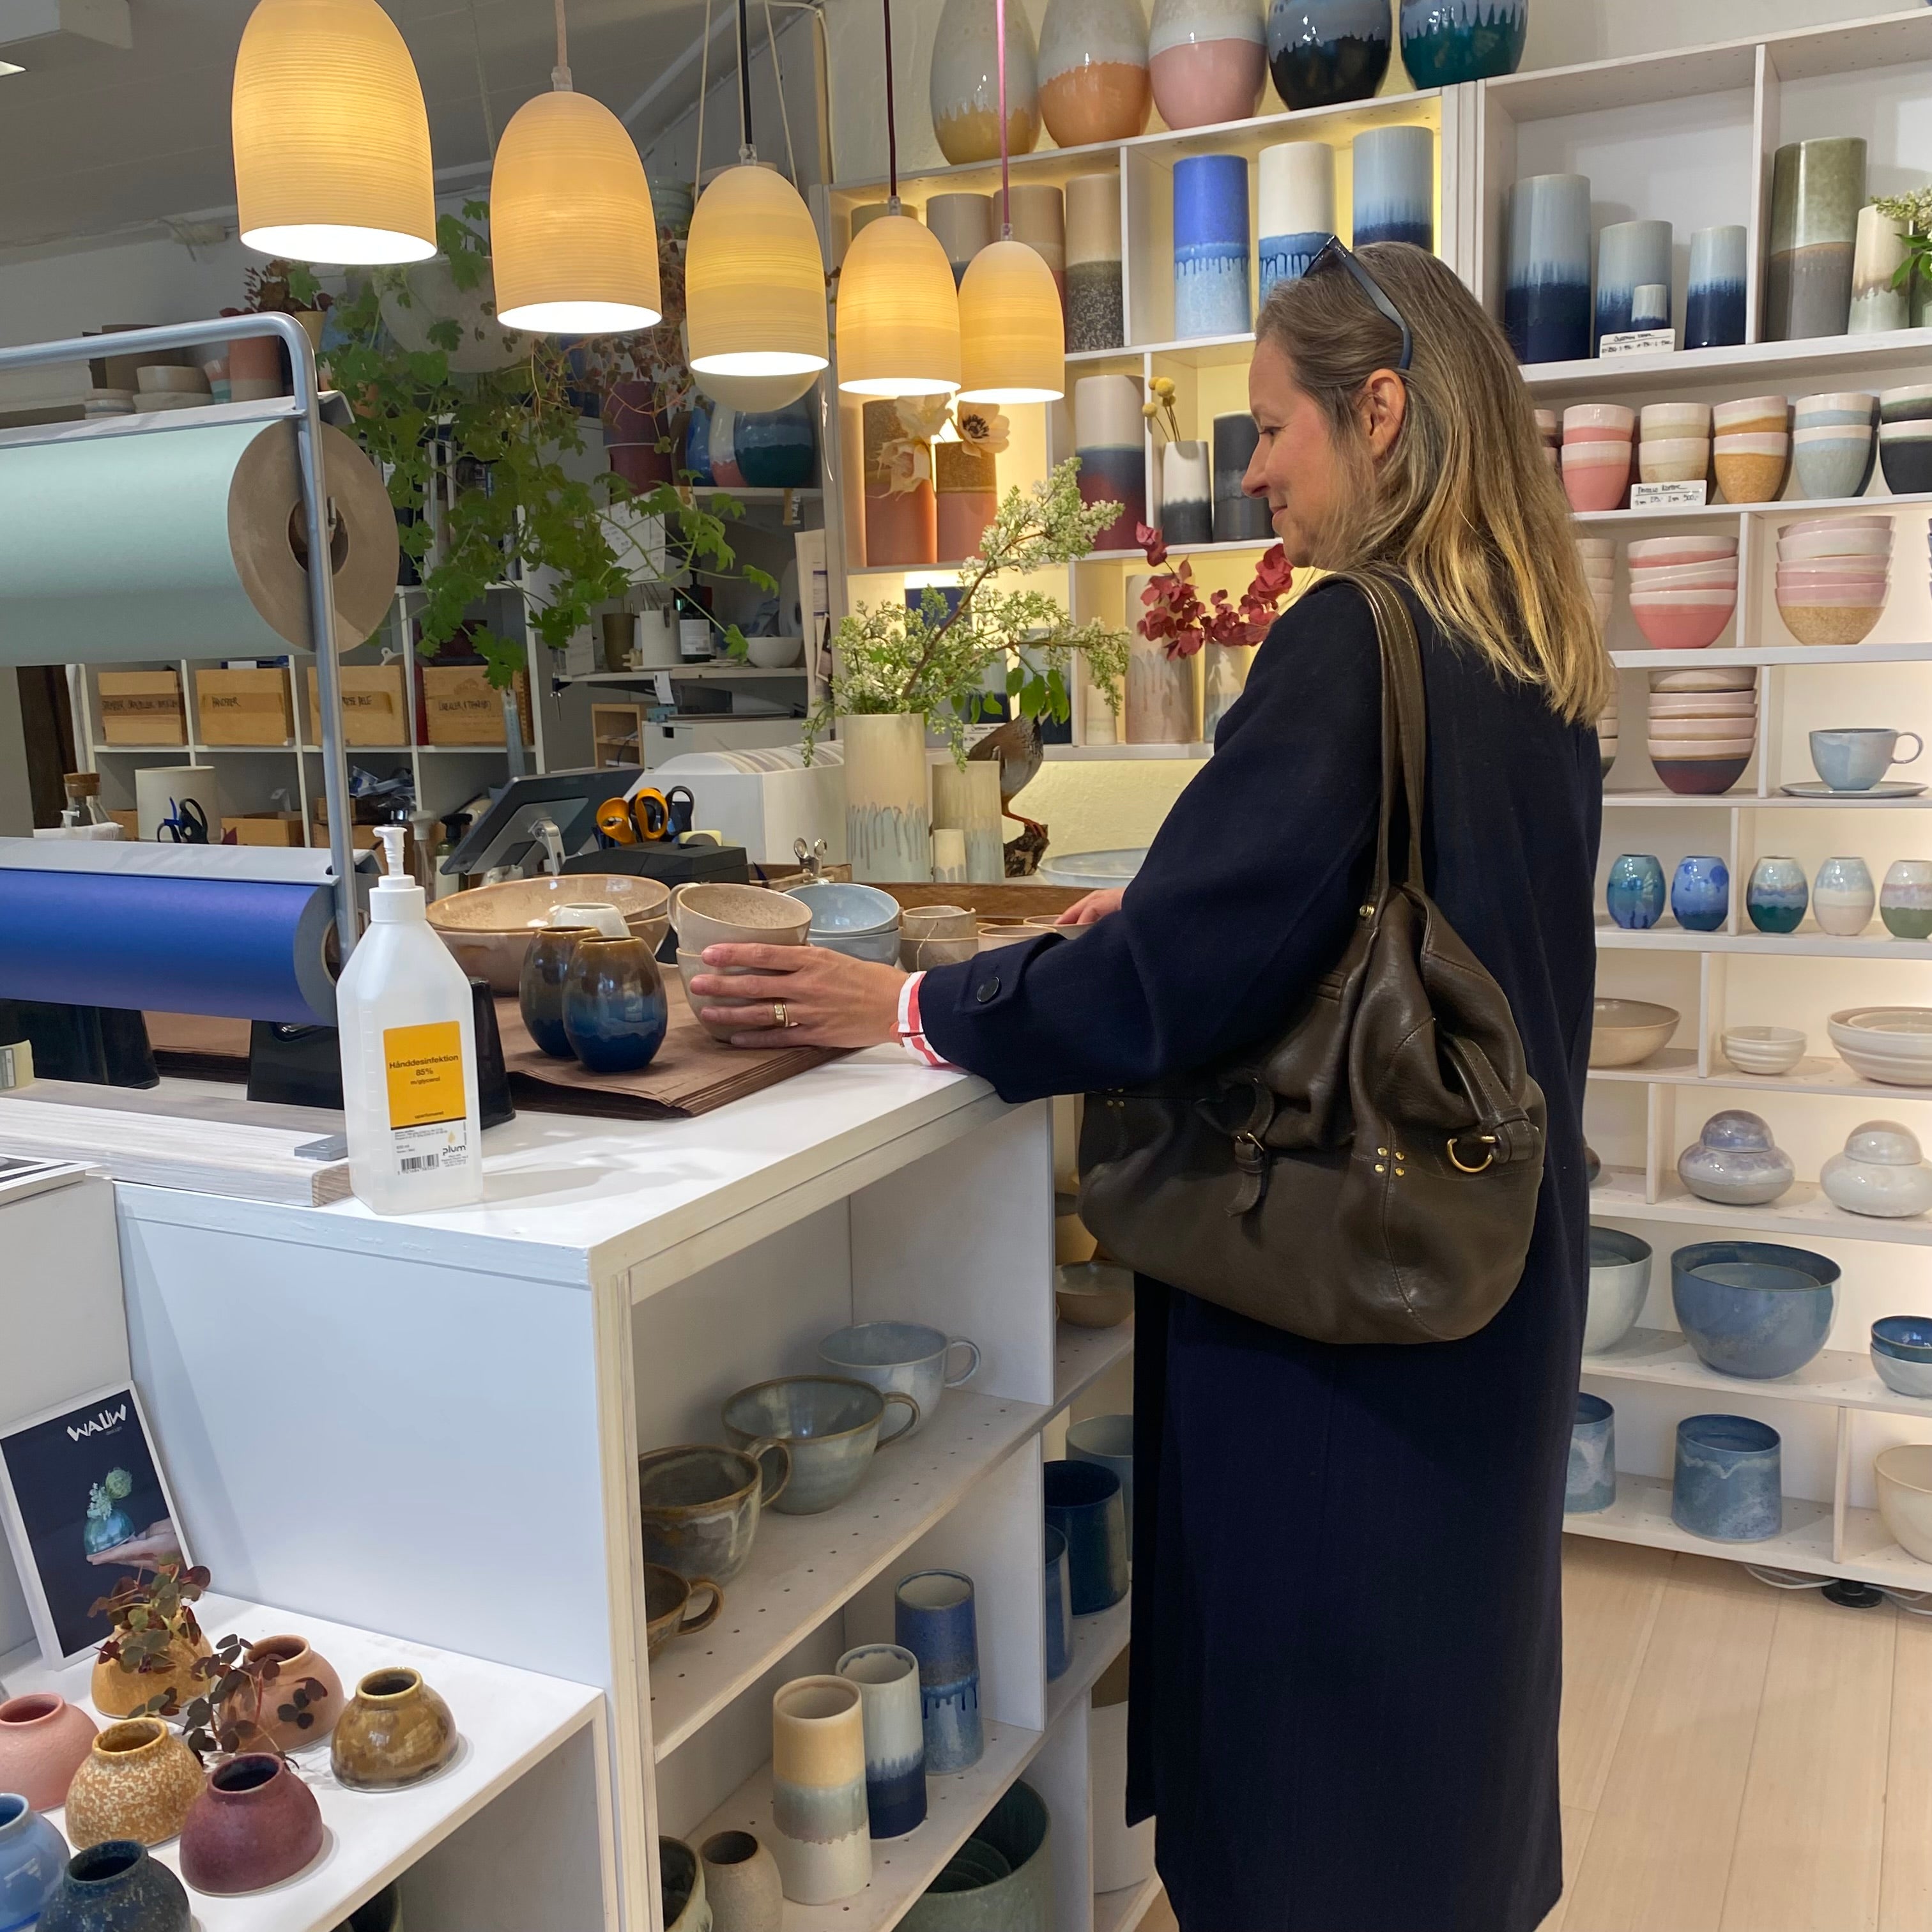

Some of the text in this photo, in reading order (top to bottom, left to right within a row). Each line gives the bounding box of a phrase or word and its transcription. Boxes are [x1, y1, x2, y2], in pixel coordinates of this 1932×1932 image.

[389, 1055, 459, 1070] Hånddesinfektion
[415, 1068, 434, 1077] 85%
[442, 1145, 466, 1156] plum
[66, 1404, 126, 1442] WAUW
